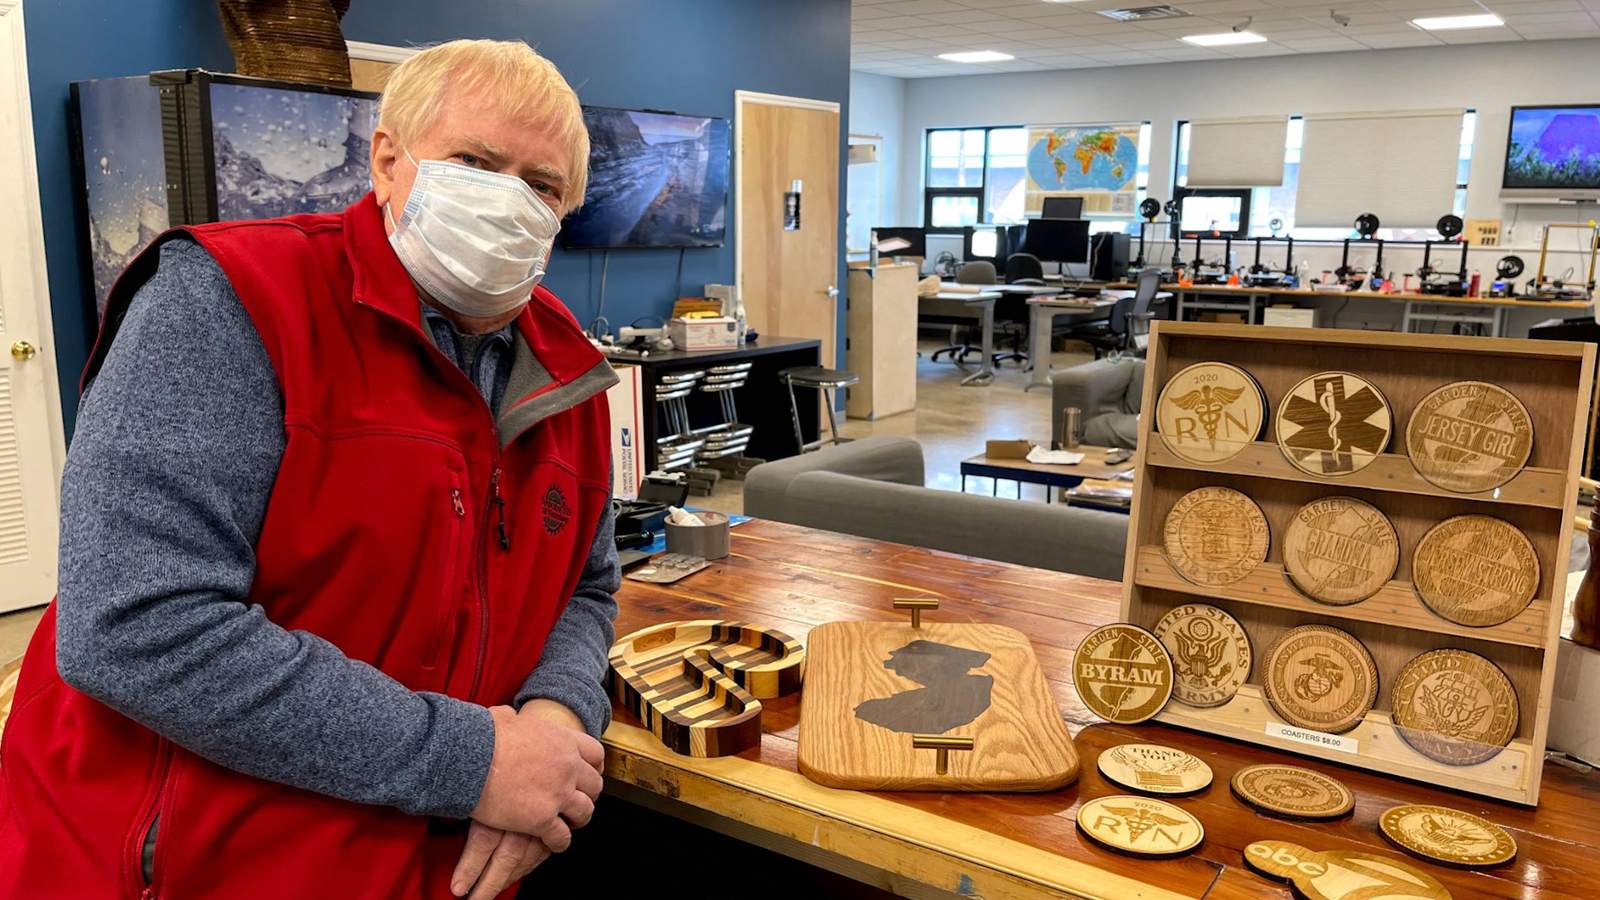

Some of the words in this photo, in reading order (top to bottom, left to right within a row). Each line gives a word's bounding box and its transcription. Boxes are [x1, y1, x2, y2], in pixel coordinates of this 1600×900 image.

[1193, 373, 1218, 384] 2020
[1427, 386, 1479, 410] GARDEN
[1501, 399, 1527, 432] STATE
[1418, 415, 1482, 447] JERSEY
[1482, 431, 1517, 459] GIRL
[1167, 488, 1210, 536] UNITED
[1299, 501, 1346, 523] GARDEN
[1366, 513, 1393, 547] STATE
[1475, 562, 1529, 595] STRONG
[1083, 629, 1119, 656] GARDEN
[1138, 635, 1165, 663] STATE
[1205, 607, 1249, 669] STATES
[1079, 663, 1164, 686] BYRAM
[1276, 637, 1319, 668] UNITED
[1328, 639, 1364, 681] STATES
[1173, 686, 1228, 702] ARMY
[1130, 746, 1184, 758] THANK
[1281, 728, 1320, 743] COASTERS
[1321, 737, 1341, 747] $8.00
[1140, 753, 1173, 762] YOU
[1133, 801, 1162, 812] 2020
[1247, 844, 1325, 876] abc
